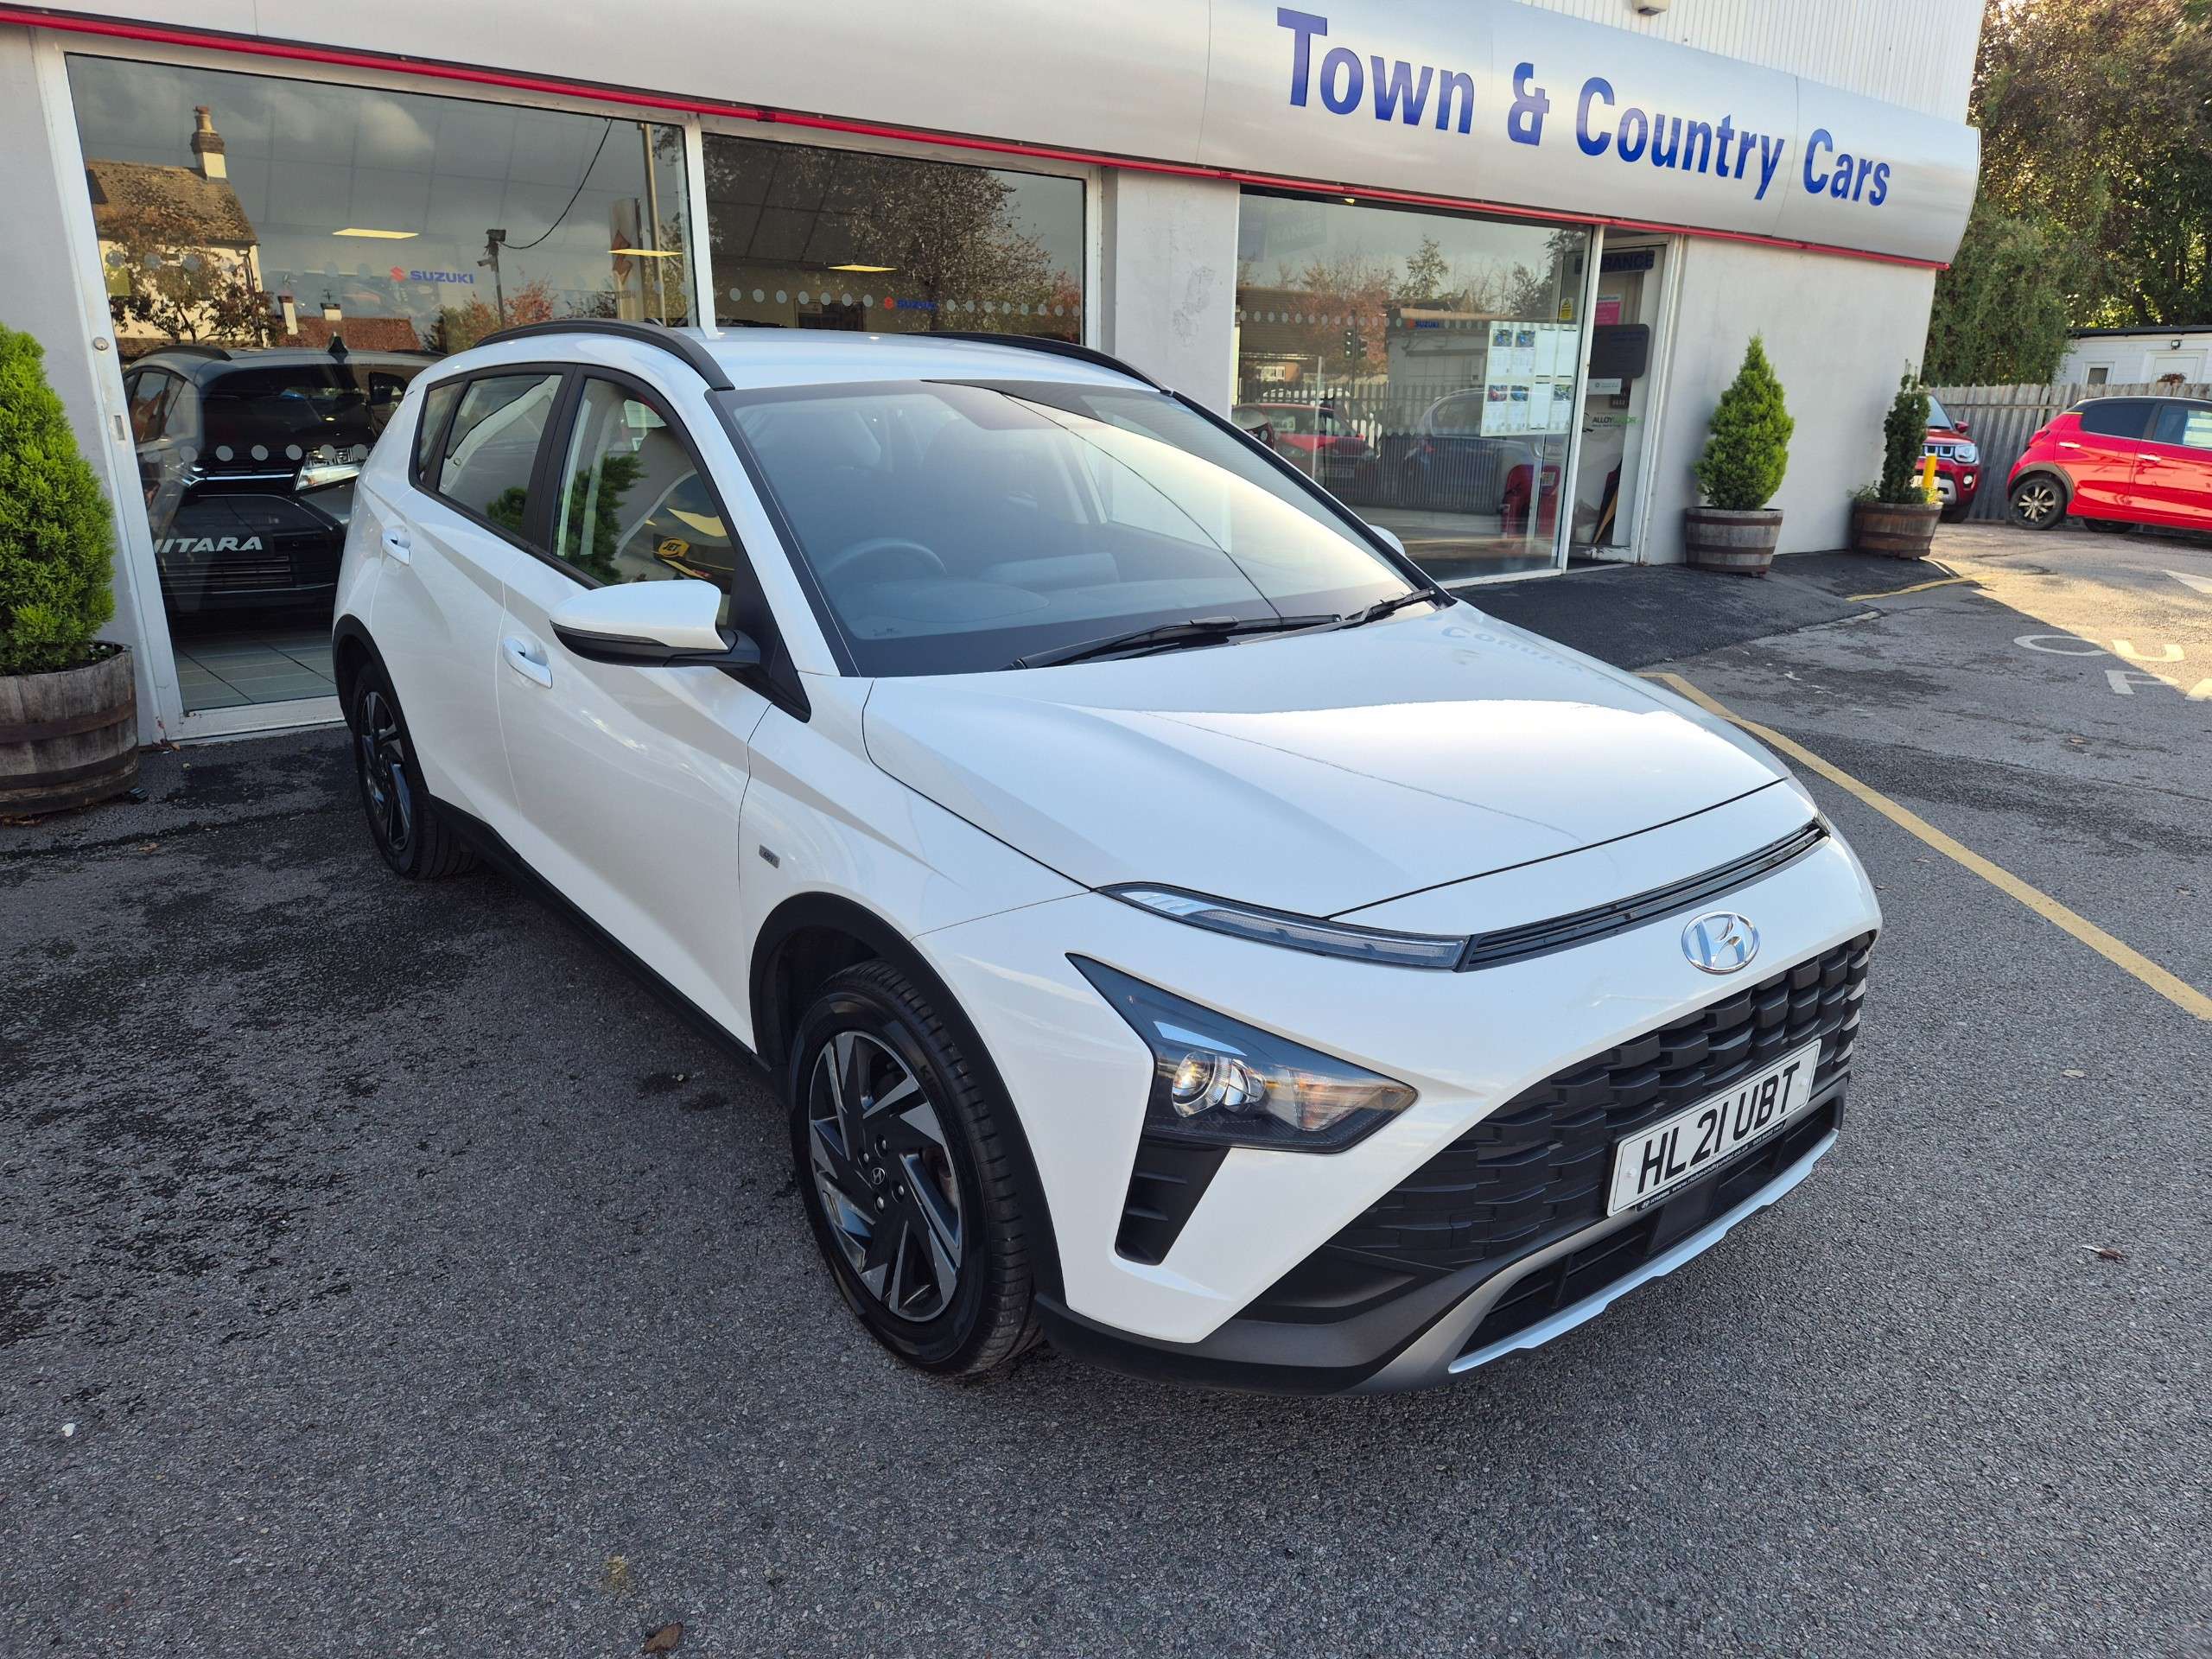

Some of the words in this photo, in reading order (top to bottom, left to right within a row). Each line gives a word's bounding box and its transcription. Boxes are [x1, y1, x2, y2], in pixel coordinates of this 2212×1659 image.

[1277, 7, 1474, 134] Town
[1507, 62, 1550, 146] &
[1575, 76, 1784, 200] Country
[1802, 128, 1891, 207] Cars
[410, 270, 474, 283] SUZUKI
[1637, 1101, 1729, 1194] HL21
[1732, 1060, 1801, 1141] UBT
